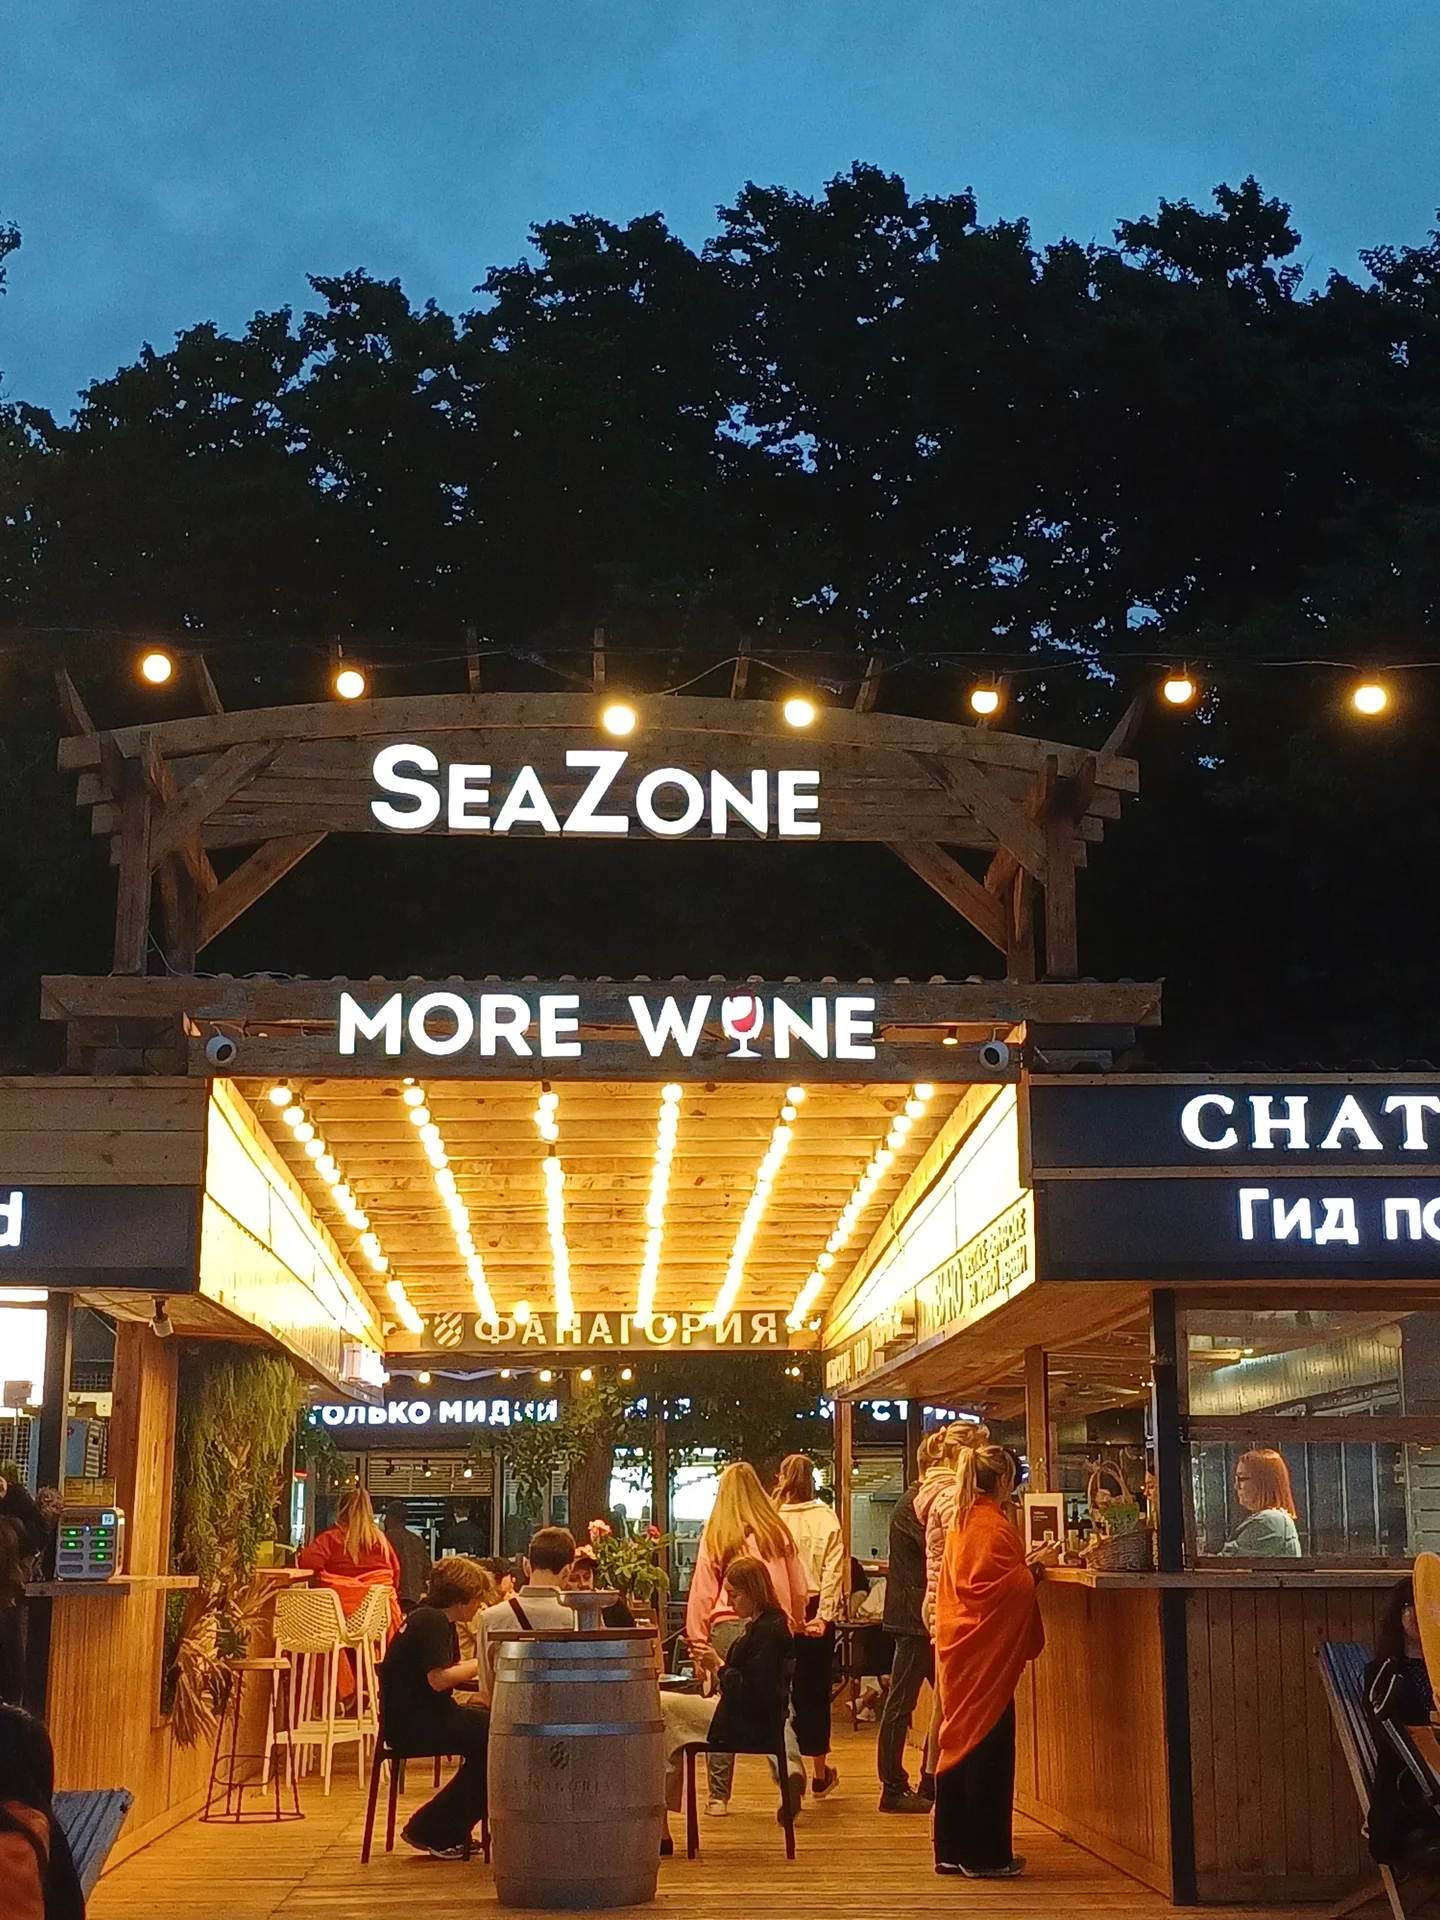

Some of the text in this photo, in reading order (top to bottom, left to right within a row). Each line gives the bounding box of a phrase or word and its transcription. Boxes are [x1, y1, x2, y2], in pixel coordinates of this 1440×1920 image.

[340, 992, 582, 1057] MORE
[1239, 1189, 1360, 1245] Гид
[474, 1312, 778, 1345] ФАНАГОРИЯ
